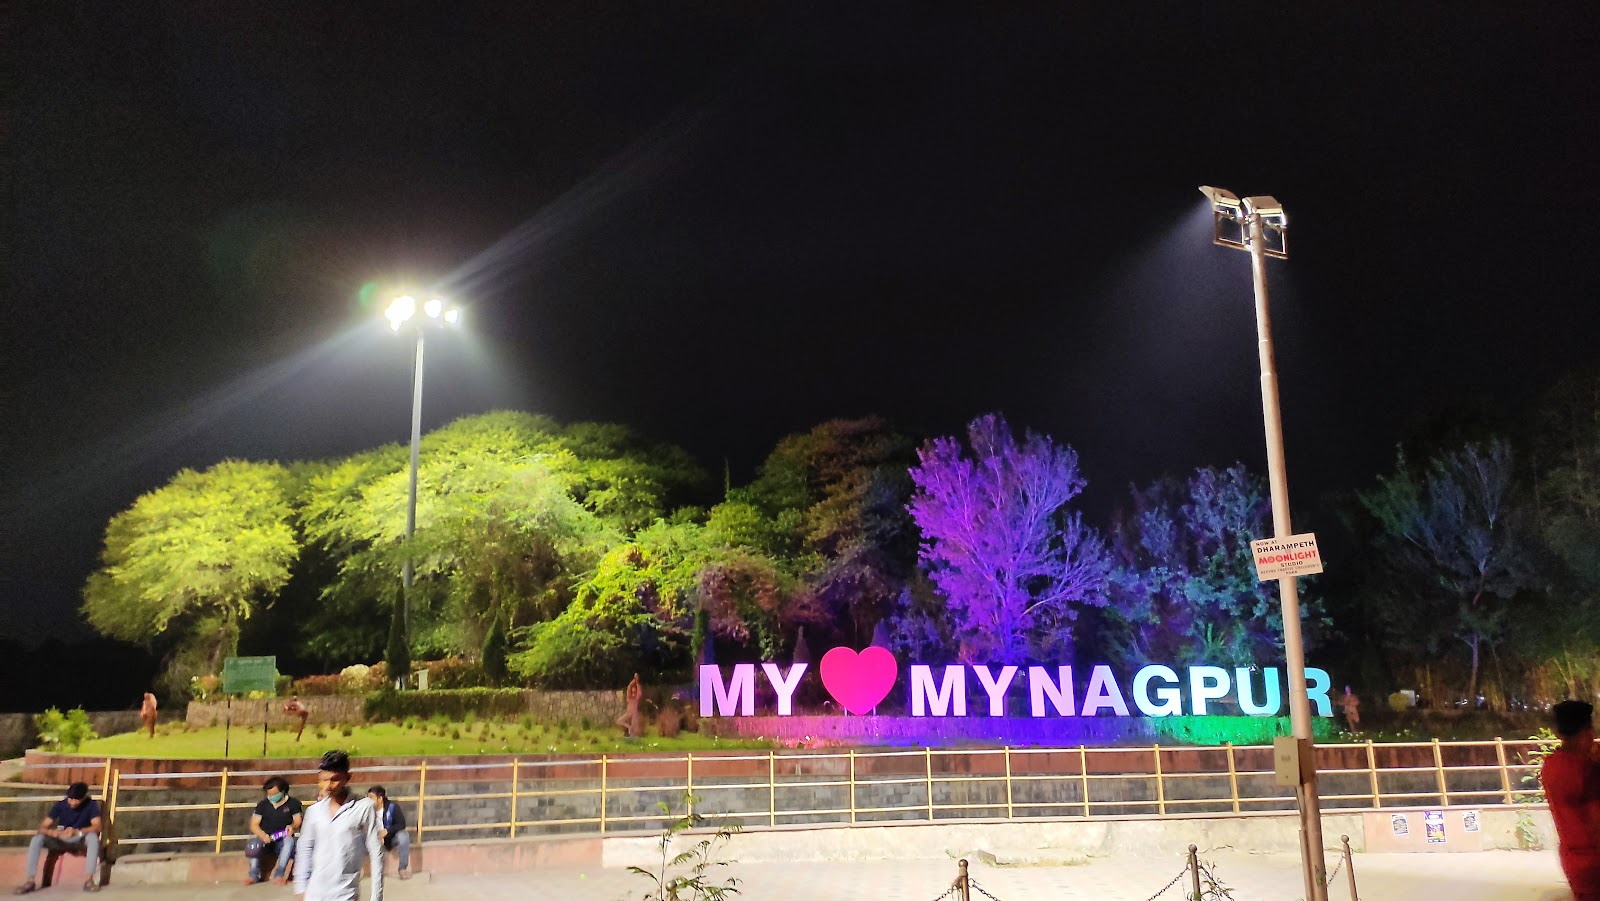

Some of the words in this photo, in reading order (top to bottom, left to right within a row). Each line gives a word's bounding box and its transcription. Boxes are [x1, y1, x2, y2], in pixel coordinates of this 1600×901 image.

[1257, 540, 1315, 554] DHARAMPETH
[1259, 550, 1317, 565] MOONLIGHT
[699, 663, 808, 718] MY
